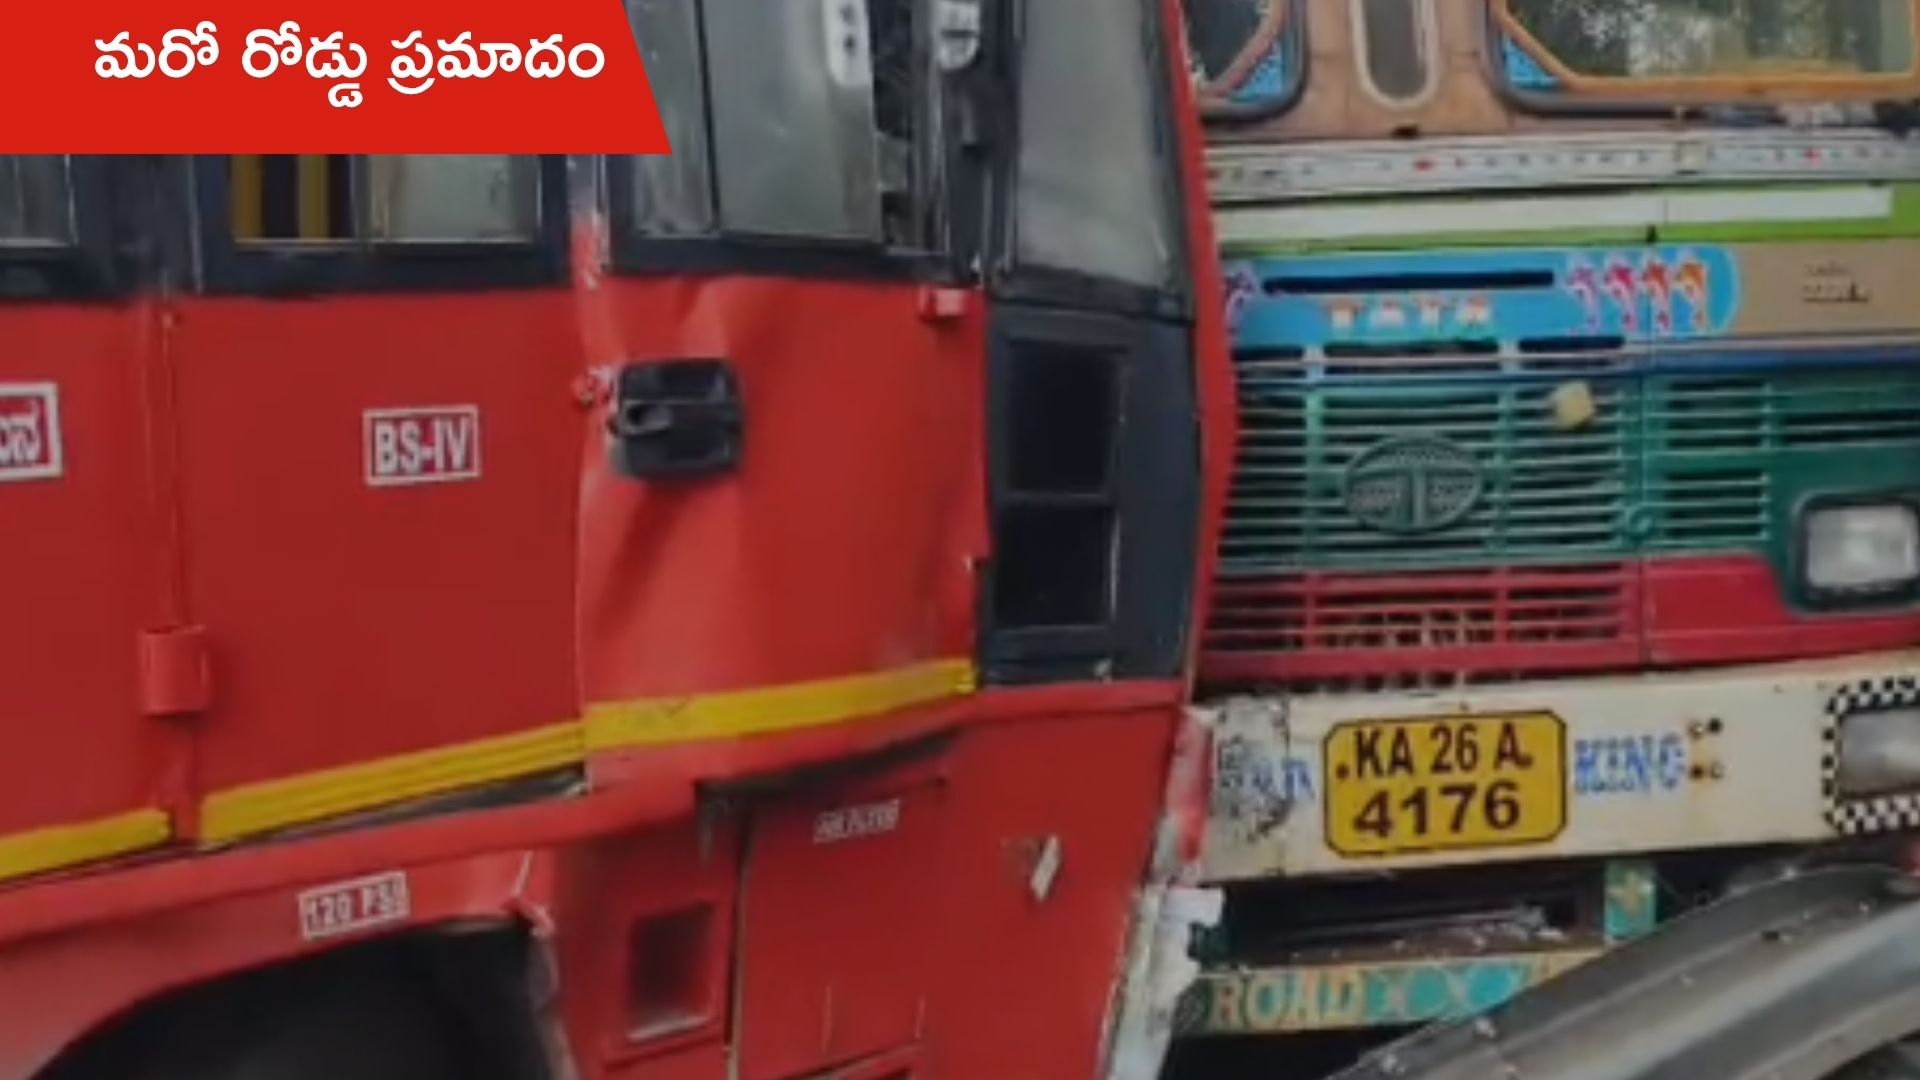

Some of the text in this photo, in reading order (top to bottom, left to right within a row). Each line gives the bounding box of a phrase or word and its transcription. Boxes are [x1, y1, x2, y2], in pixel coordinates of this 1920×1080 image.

[375, 416, 471, 474] BS-IV
[1354, 725, 1414, 778] KA
[1430, 722, 1479, 774] 26
[1353, 781, 1520, 838] 4176
[1210, 967, 1364, 1032] ROAD
